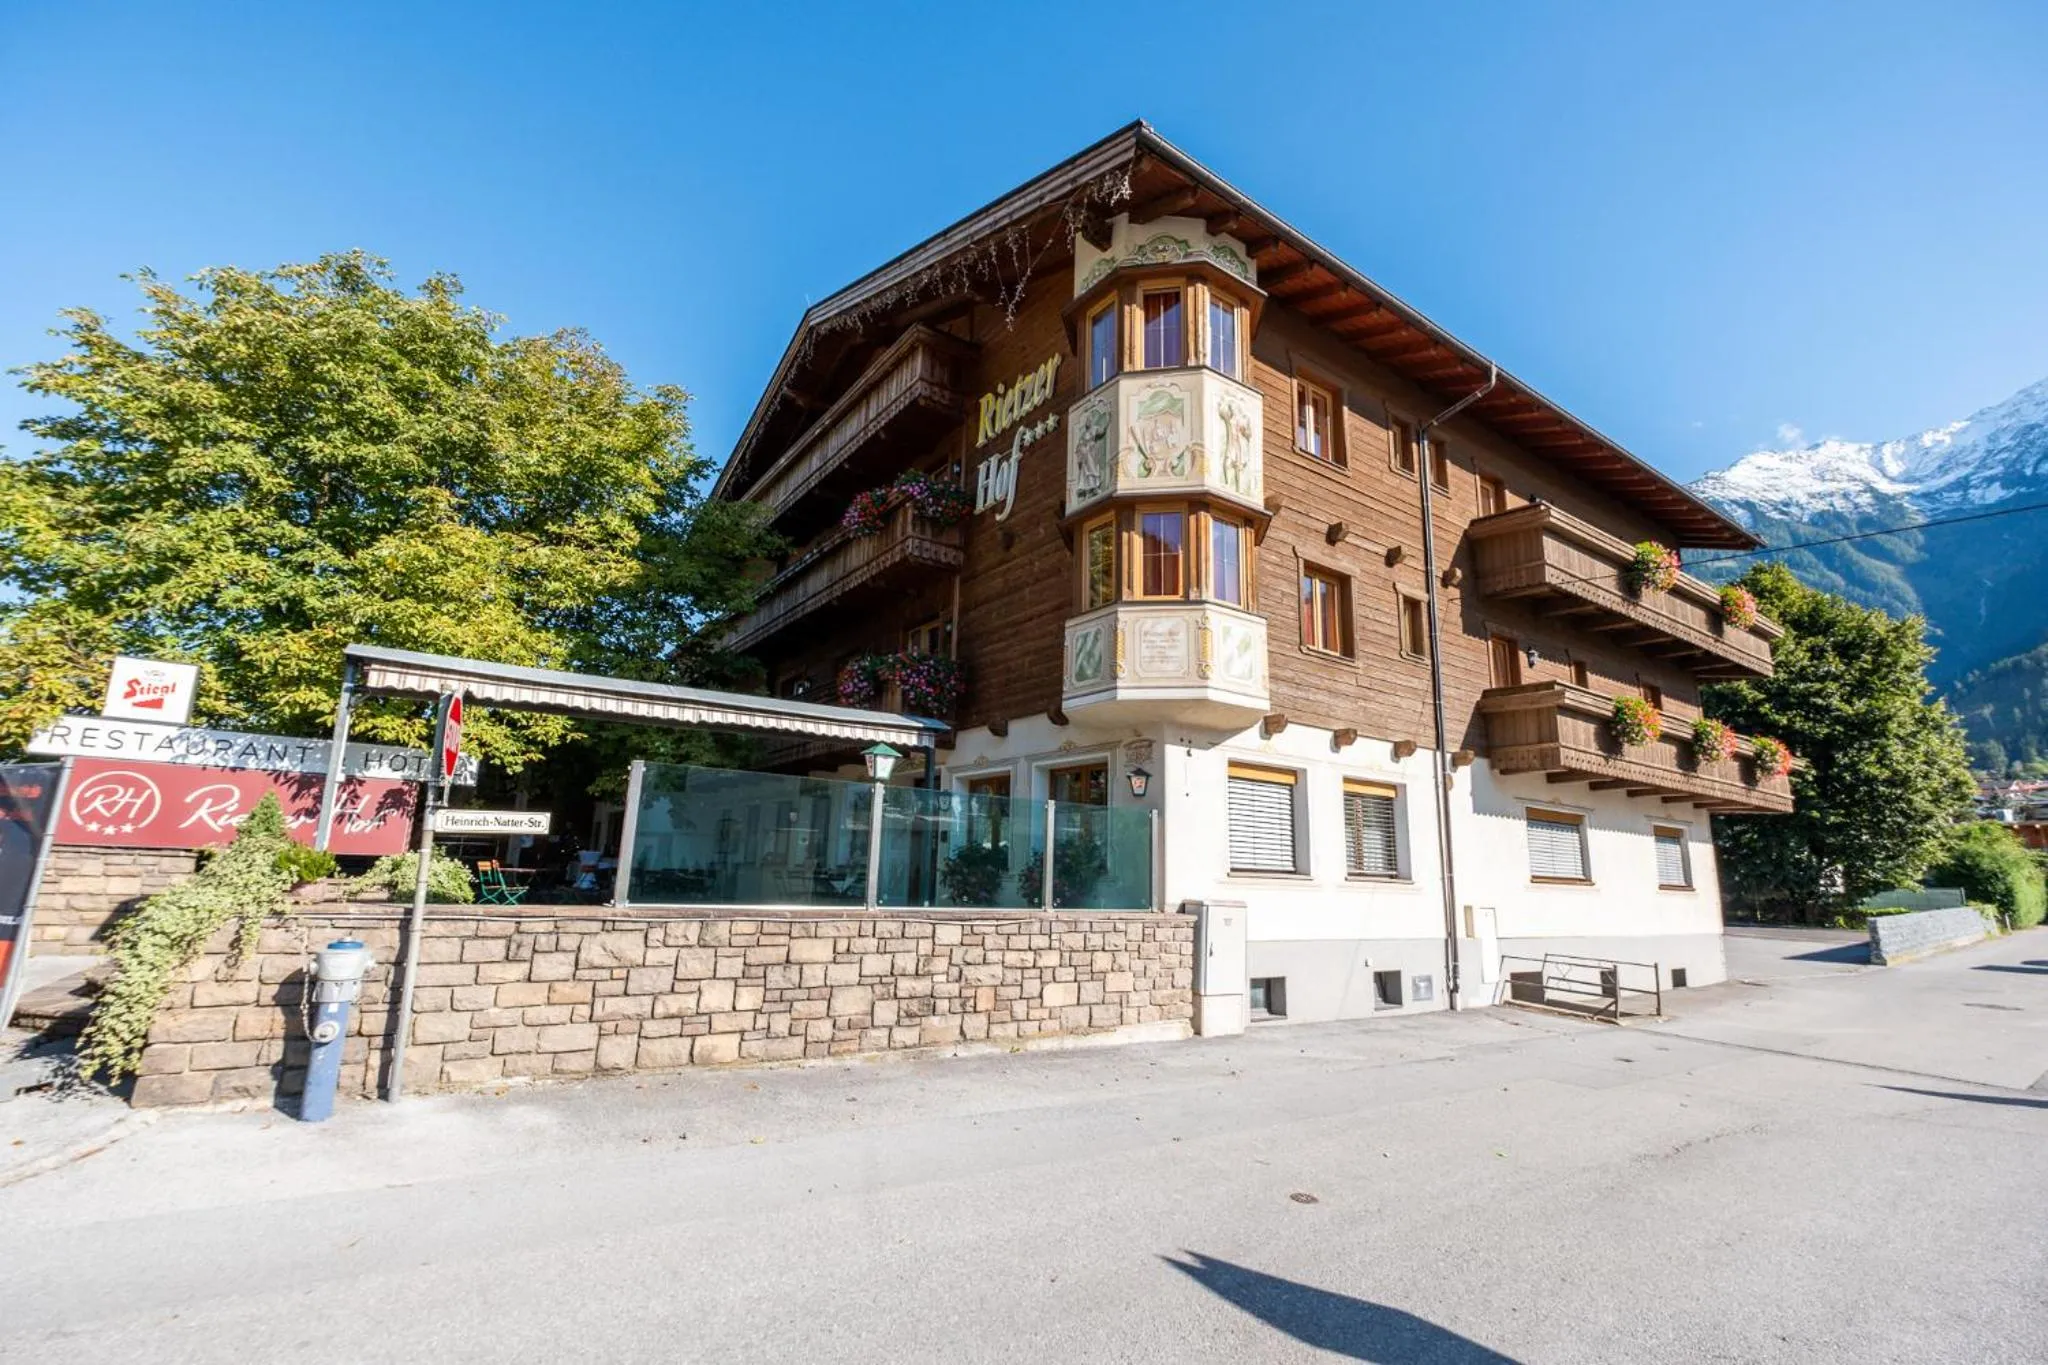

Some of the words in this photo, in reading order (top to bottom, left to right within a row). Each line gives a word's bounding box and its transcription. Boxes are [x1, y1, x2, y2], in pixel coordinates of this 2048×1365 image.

[976, 353, 1062, 448] Rietzer
[973, 426, 1023, 521] Hof
[48, 725, 314, 763] RESTAURANT
[81, 784, 152, 819] RH
[445, 815, 545, 828] Heinrich-Natter-Str.
